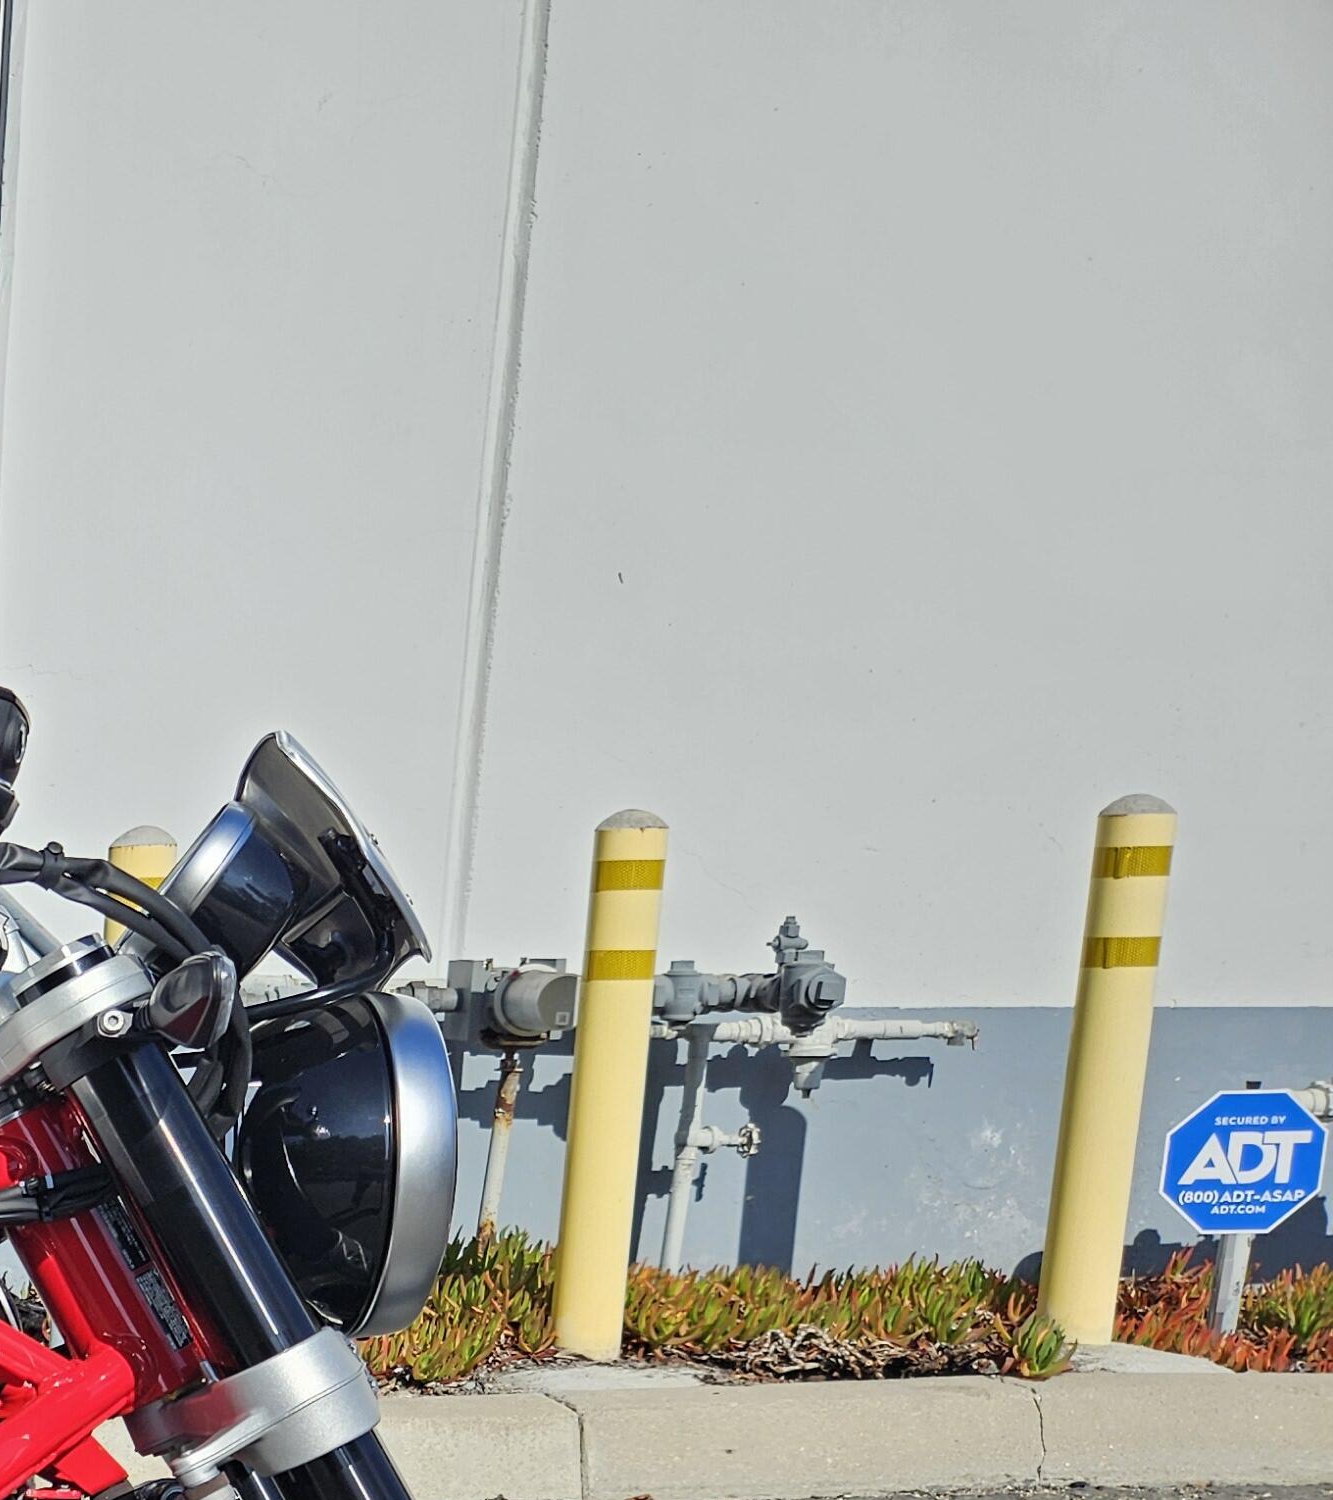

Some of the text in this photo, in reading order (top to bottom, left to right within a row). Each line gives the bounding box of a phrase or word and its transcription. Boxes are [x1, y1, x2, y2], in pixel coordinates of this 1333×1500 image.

[1214, 1115, 1286, 1126] SECURED BY
[1177, 1130, 1313, 1185] ADT
[1210, 1205, 1266, 1215] ADT.COM
